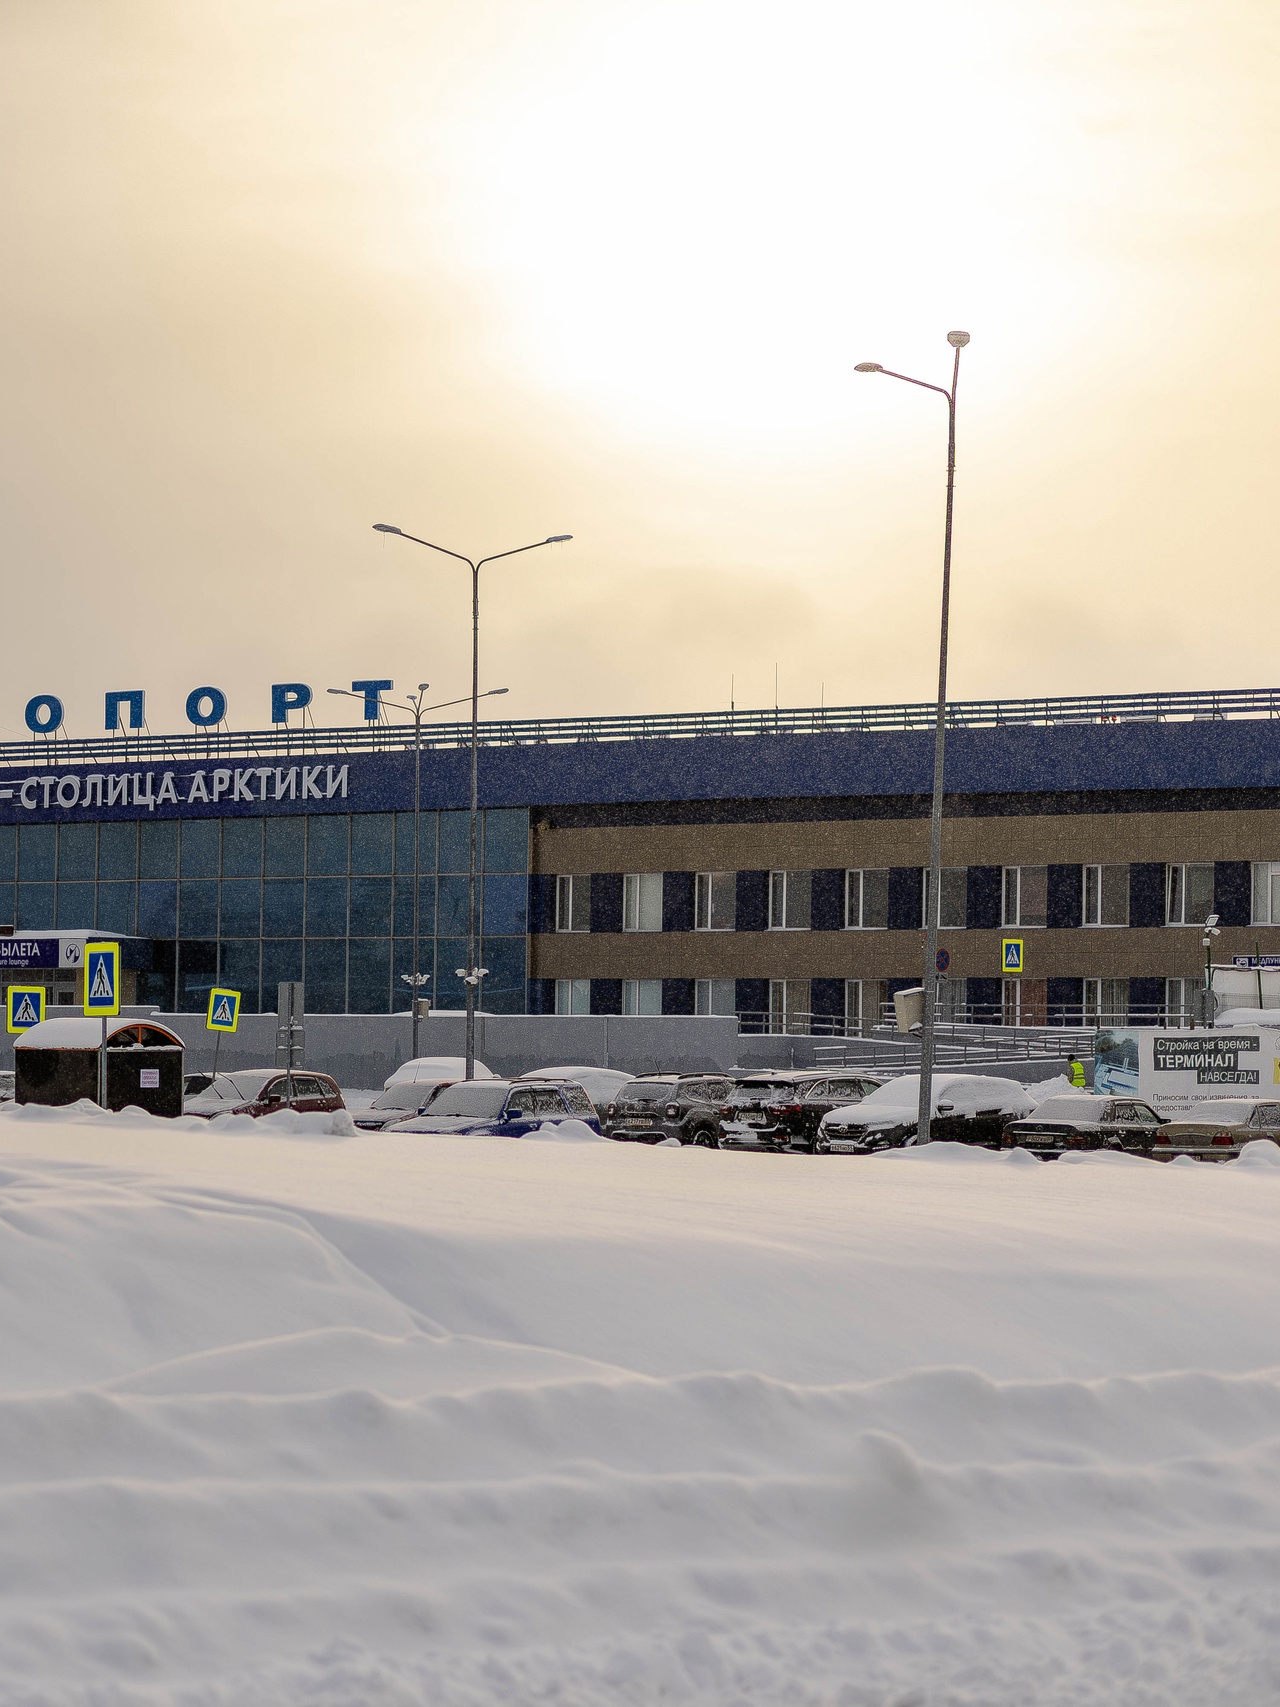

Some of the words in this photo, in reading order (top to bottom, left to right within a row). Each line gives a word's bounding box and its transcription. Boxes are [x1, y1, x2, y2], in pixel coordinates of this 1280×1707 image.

[20, 772, 178, 811] СТОЛИЦА
[187, 765, 349, 804] АРКТИКИ
[9, 958, 29, 967] lounge
[1156, 1039, 1200, 1052] Стройка
[1202, 1041, 1215, 1049] на
[1218, 1040, 1251, 1051] время
[1157, 1053, 1234, 1068] ТЕРМИНАЛ
[1199, 1071, 1257, 1084] НАВСЕГДА!
[1152, 1094, 1189, 1102] Приносим
